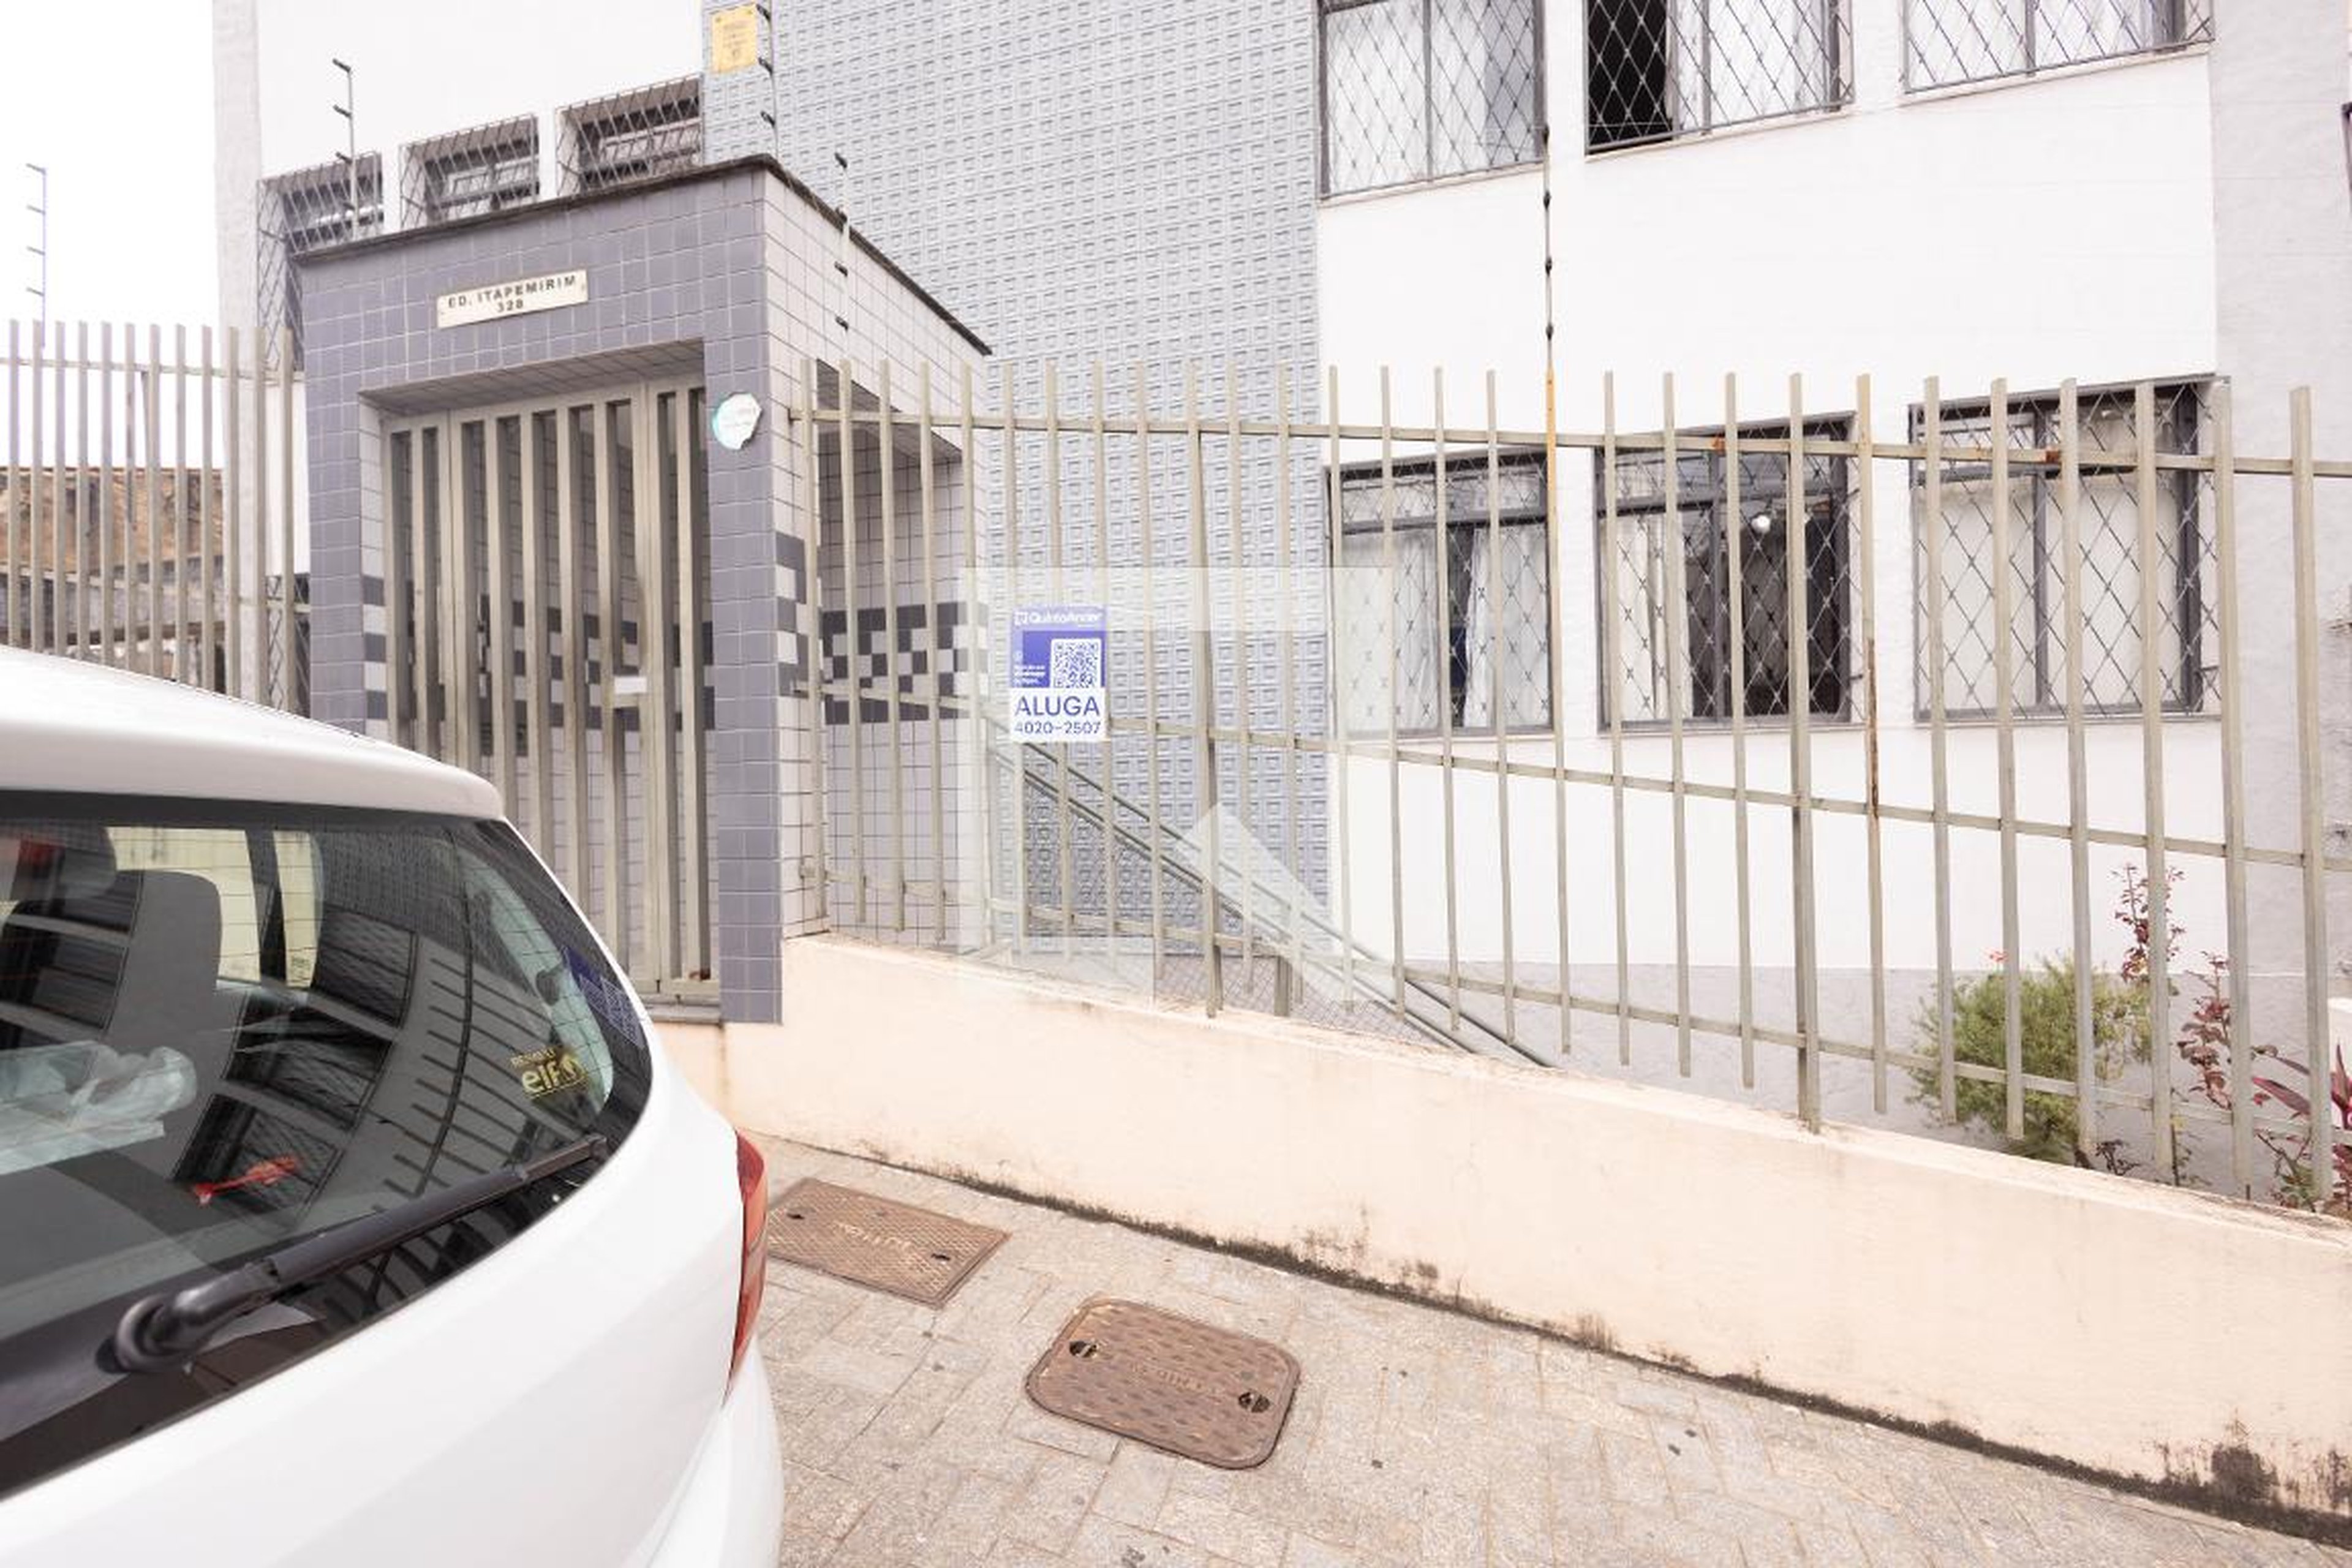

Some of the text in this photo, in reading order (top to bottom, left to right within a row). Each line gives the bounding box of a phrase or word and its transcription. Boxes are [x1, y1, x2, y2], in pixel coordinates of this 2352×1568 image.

[448, 274, 576, 308] ED. ITAPEMIRIM
[497, 300, 524, 313] 328
[1015, 696, 1100, 717] ALUGA
[1014, 720, 1101, 734] 4020-2507
[522, 1060, 560, 1093] elf
